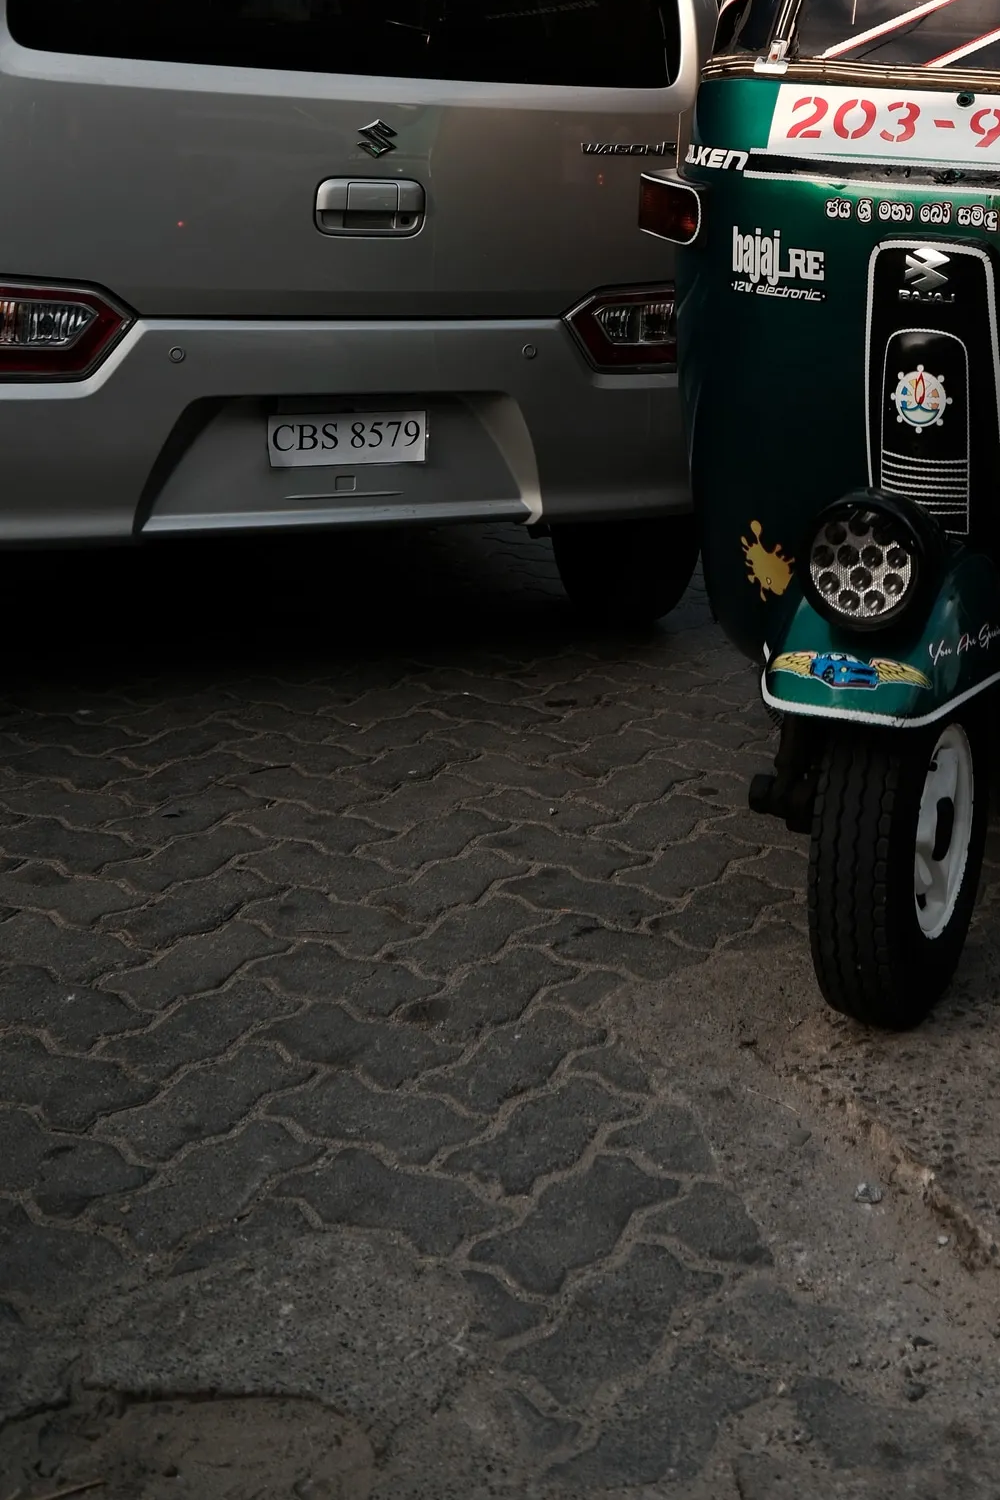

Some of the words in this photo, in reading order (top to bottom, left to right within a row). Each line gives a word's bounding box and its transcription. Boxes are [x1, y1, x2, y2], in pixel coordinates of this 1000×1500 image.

[878, 202, 913, 221] මහා
[756, 283, 822, 302] electronic
[272, 423, 339, 451] CBS
[350, 420, 421, 449] 8579
